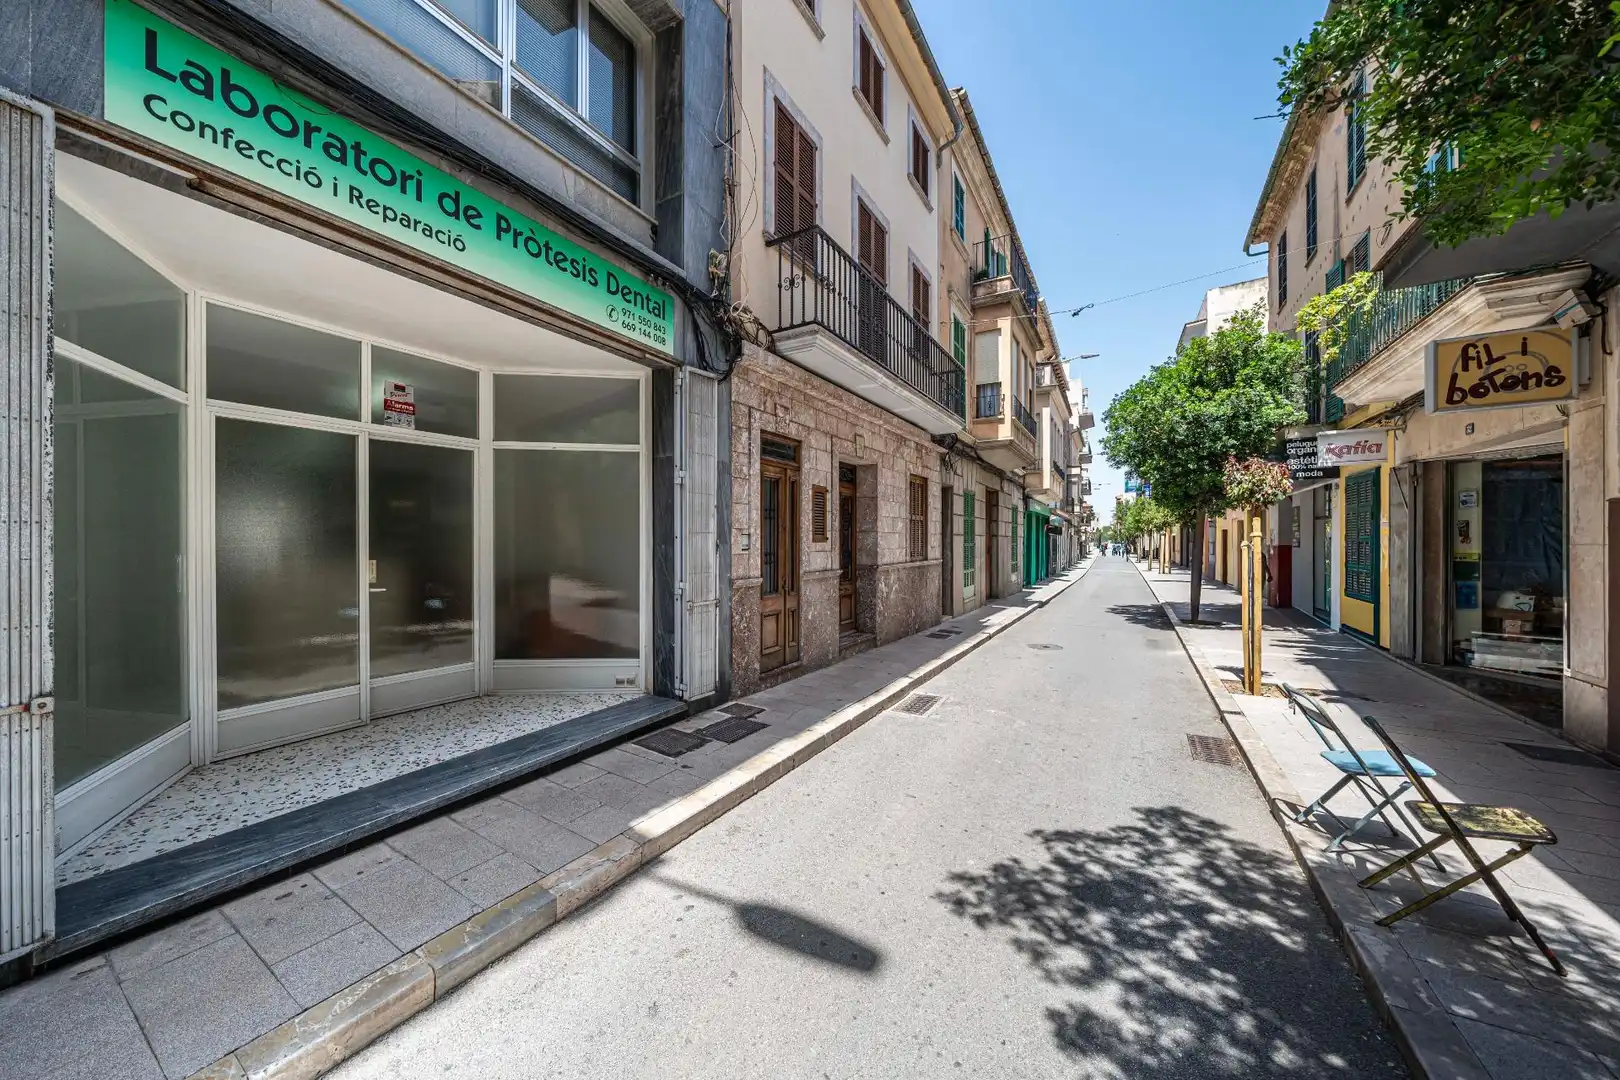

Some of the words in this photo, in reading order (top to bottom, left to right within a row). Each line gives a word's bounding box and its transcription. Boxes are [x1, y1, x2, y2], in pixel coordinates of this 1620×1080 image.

[143, 94, 323, 189] Confecció
[332, 176, 338, 197] i
[349, 184, 466, 252] Reparació
[145, 27, 423, 202] Laboratori
[437, 190, 483, 231] de
[495, 212, 599, 288] Pròtesis
[607, 270, 665, 320] Dental
[621, 307, 635, 321] 971
[638, 315, 652, 328] 550
[653, 322, 666, 335] 843
[621, 320, 636, 332] 669
[638, 328, 651, 339] 144
[653, 333, 666, 346] 008
[1521, 336, 1528, 356] i
